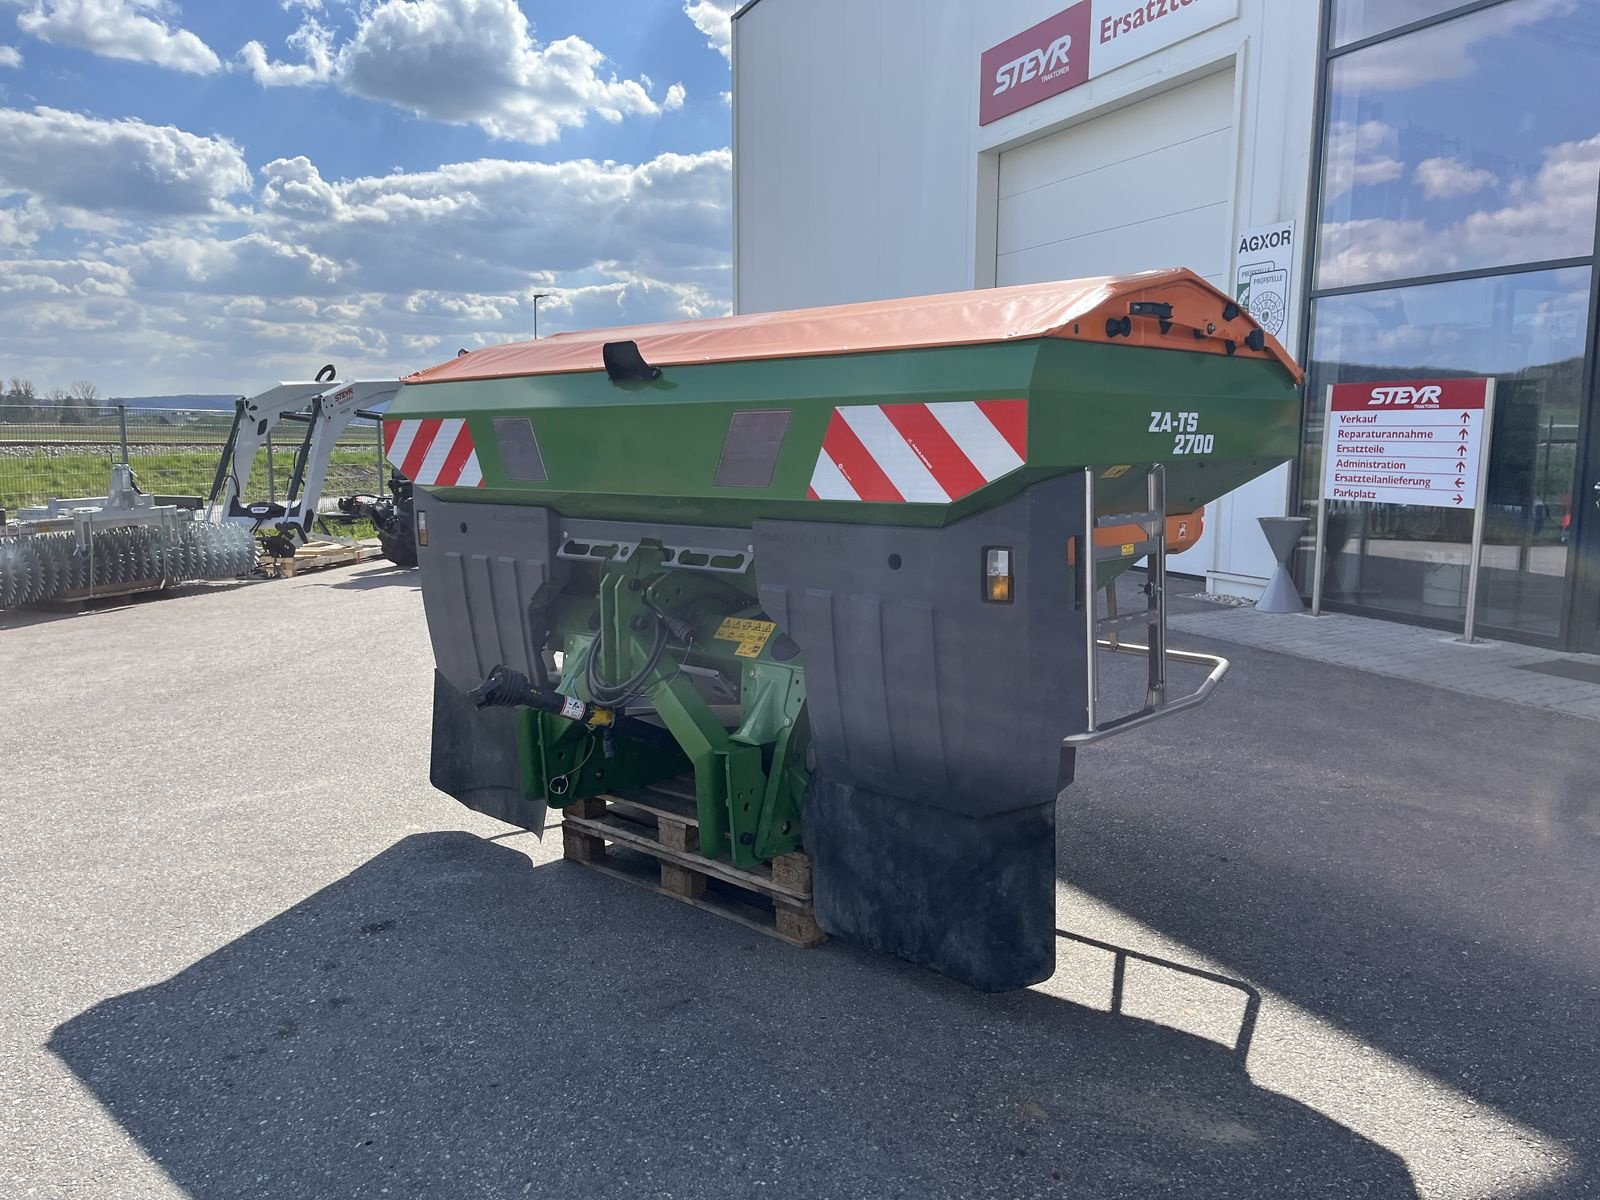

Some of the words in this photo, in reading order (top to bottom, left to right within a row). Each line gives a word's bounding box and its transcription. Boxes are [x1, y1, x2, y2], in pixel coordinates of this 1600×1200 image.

[992, 34, 1072, 97] STEYR
[1041, 65, 1070, 83] TRAKTOREN
[1238, 229, 1291, 254] AGXOR
[334, 387, 354, 402] STEYR
[1367, 385, 1443, 405] STEYR
[1148, 411, 1199, 433] ZA-TS
[1340, 414, 1378, 424] Verkauf
[1337, 429, 1434, 441] Reparaturannahme
[1172, 434, 1214, 455] 2700
[1336, 444, 1385, 454] Ersatzteile
[1335, 459, 1406, 470] Administration
[1334, 473, 1431, 489] Ersatzteilanlieferung
[1333, 488, 1377, 500] Parkplatz
